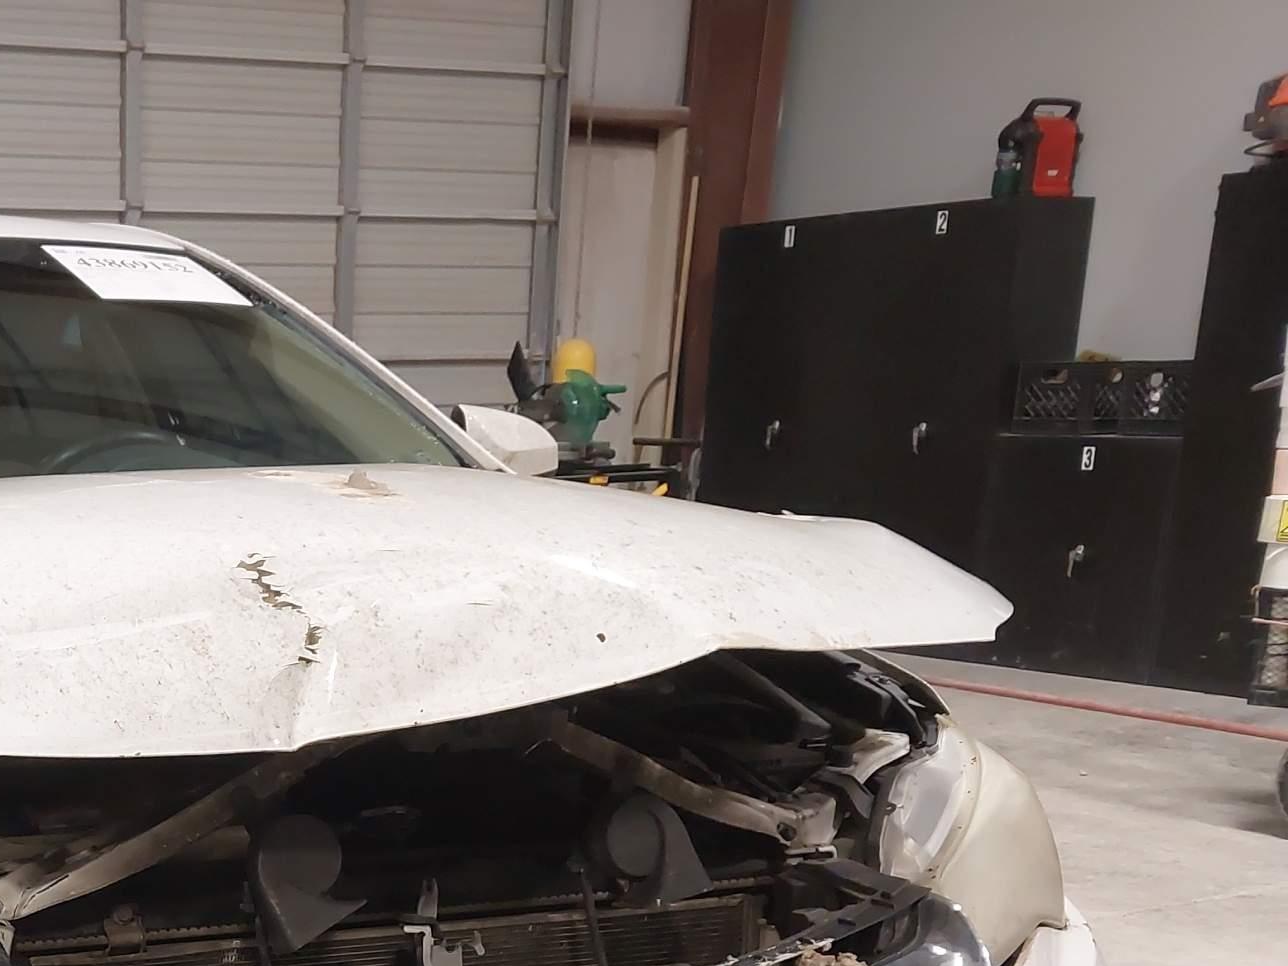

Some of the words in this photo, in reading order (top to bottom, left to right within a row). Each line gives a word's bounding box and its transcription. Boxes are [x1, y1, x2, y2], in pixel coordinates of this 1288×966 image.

[937, 211, 947, 232] 2
[76, 257, 193, 273] 43869152
[1083, 447, 1093, 468] 3
